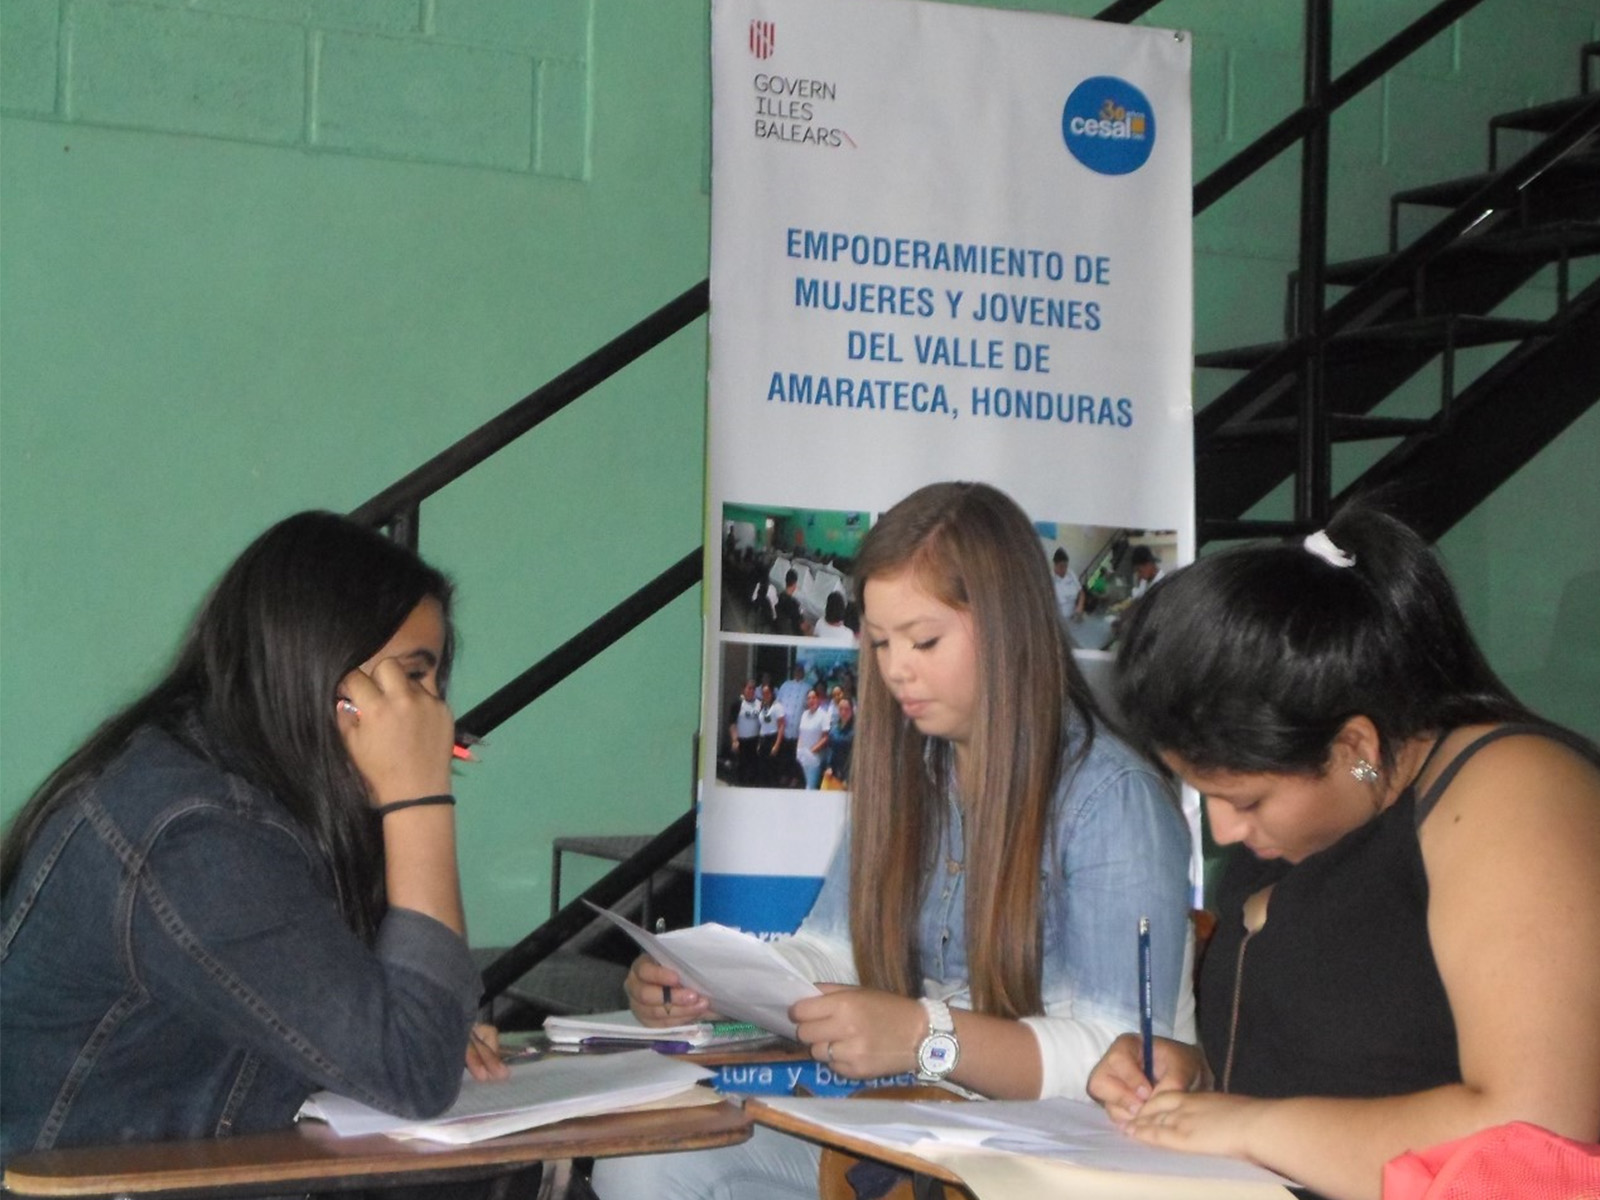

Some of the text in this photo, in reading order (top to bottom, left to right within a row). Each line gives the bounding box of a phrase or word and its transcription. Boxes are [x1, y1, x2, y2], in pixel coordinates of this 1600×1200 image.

[754, 73, 836, 101] GOVERN
[756, 96, 814, 122] ILLES
[754, 119, 843, 148] BALEARS
[1070, 116, 1132, 140] cesal
[786, 227, 1110, 285] EMPODERAMIENTO DE
[795, 277, 1102, 332] MUJERES Y JOVENES
[847, 330, 1051, 373] DEL VALLE DE
[767, 371, 1134, 429] AMARATECA, HONDURAS
[786, 1066, 803, 1090] y
